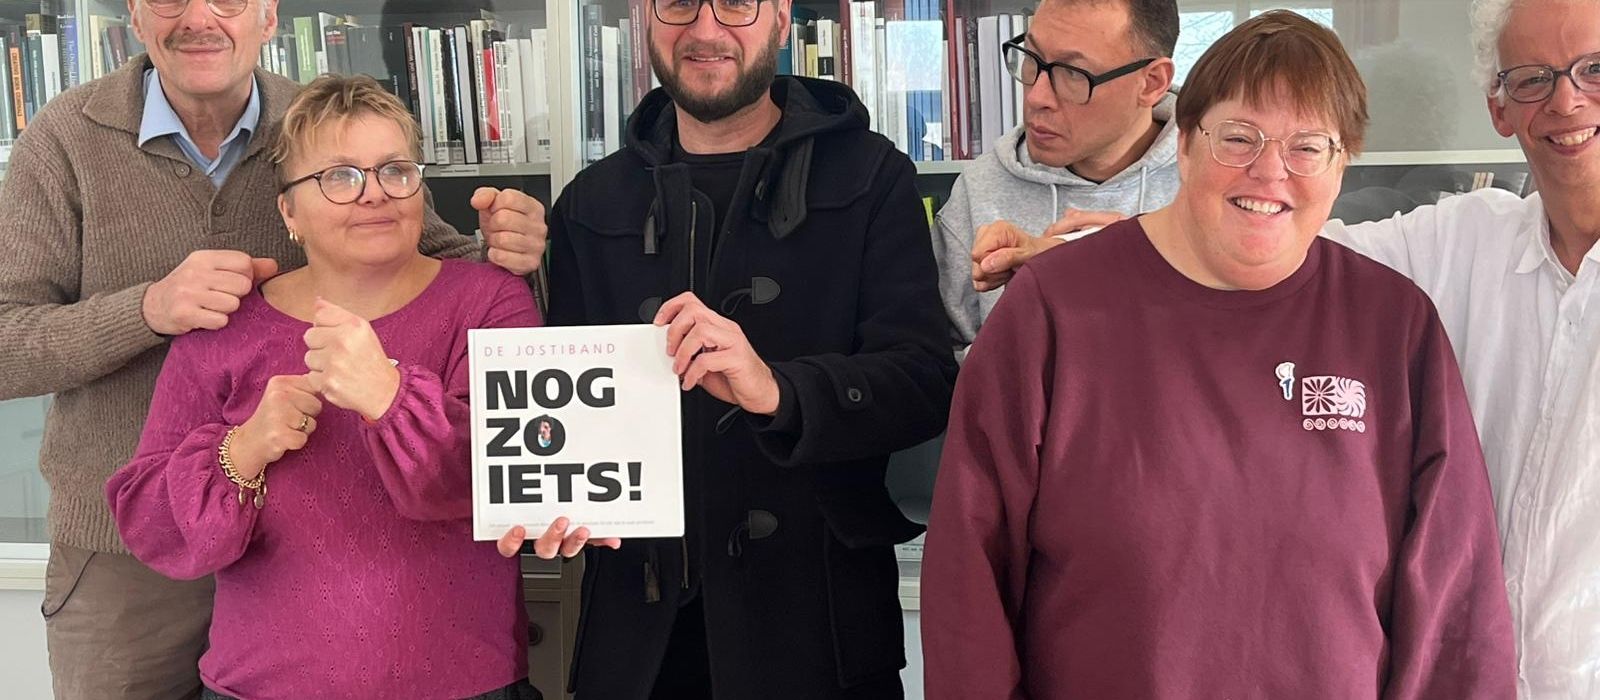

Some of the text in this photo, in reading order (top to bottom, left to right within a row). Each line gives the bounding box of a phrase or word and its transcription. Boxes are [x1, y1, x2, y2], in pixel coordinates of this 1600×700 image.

[484, 343, 616, 357] DE JOSTIBAND
[485, 367, 616, 411] NOG
[486, 414, 567, 458] ZO
[488, 461, 643, 504] IETS!
